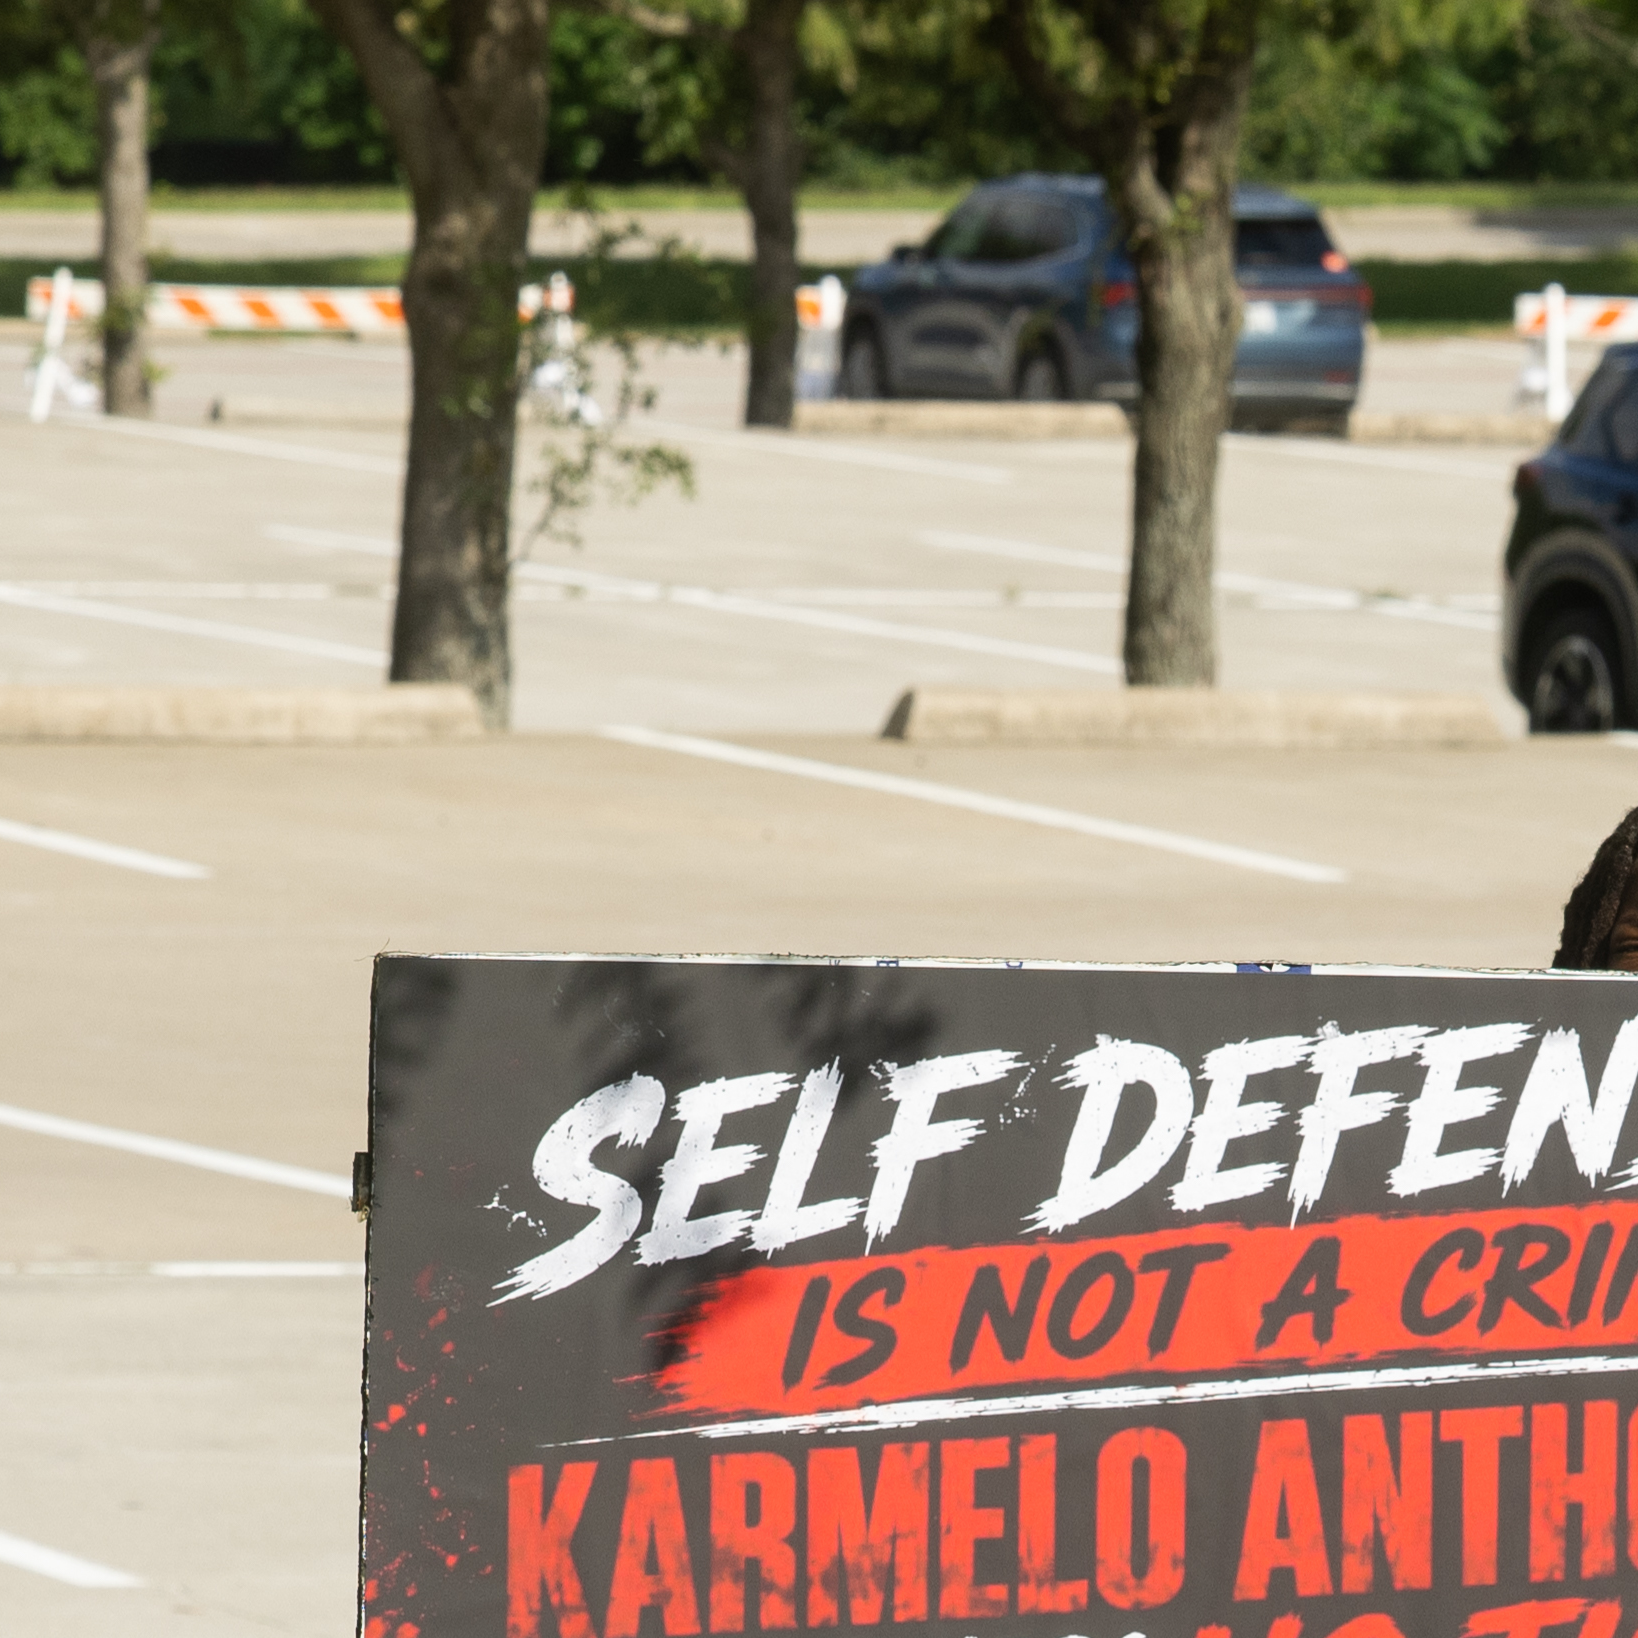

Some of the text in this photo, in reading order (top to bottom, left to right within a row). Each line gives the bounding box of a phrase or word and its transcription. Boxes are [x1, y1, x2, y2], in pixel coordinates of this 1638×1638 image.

[488, 1046, 1031, 1310] SELF
[778, 1267, 907, 1396] IS
[946, 1239, 1235, 1373] NOT
[1257, 1234, 1354, 1345] A
